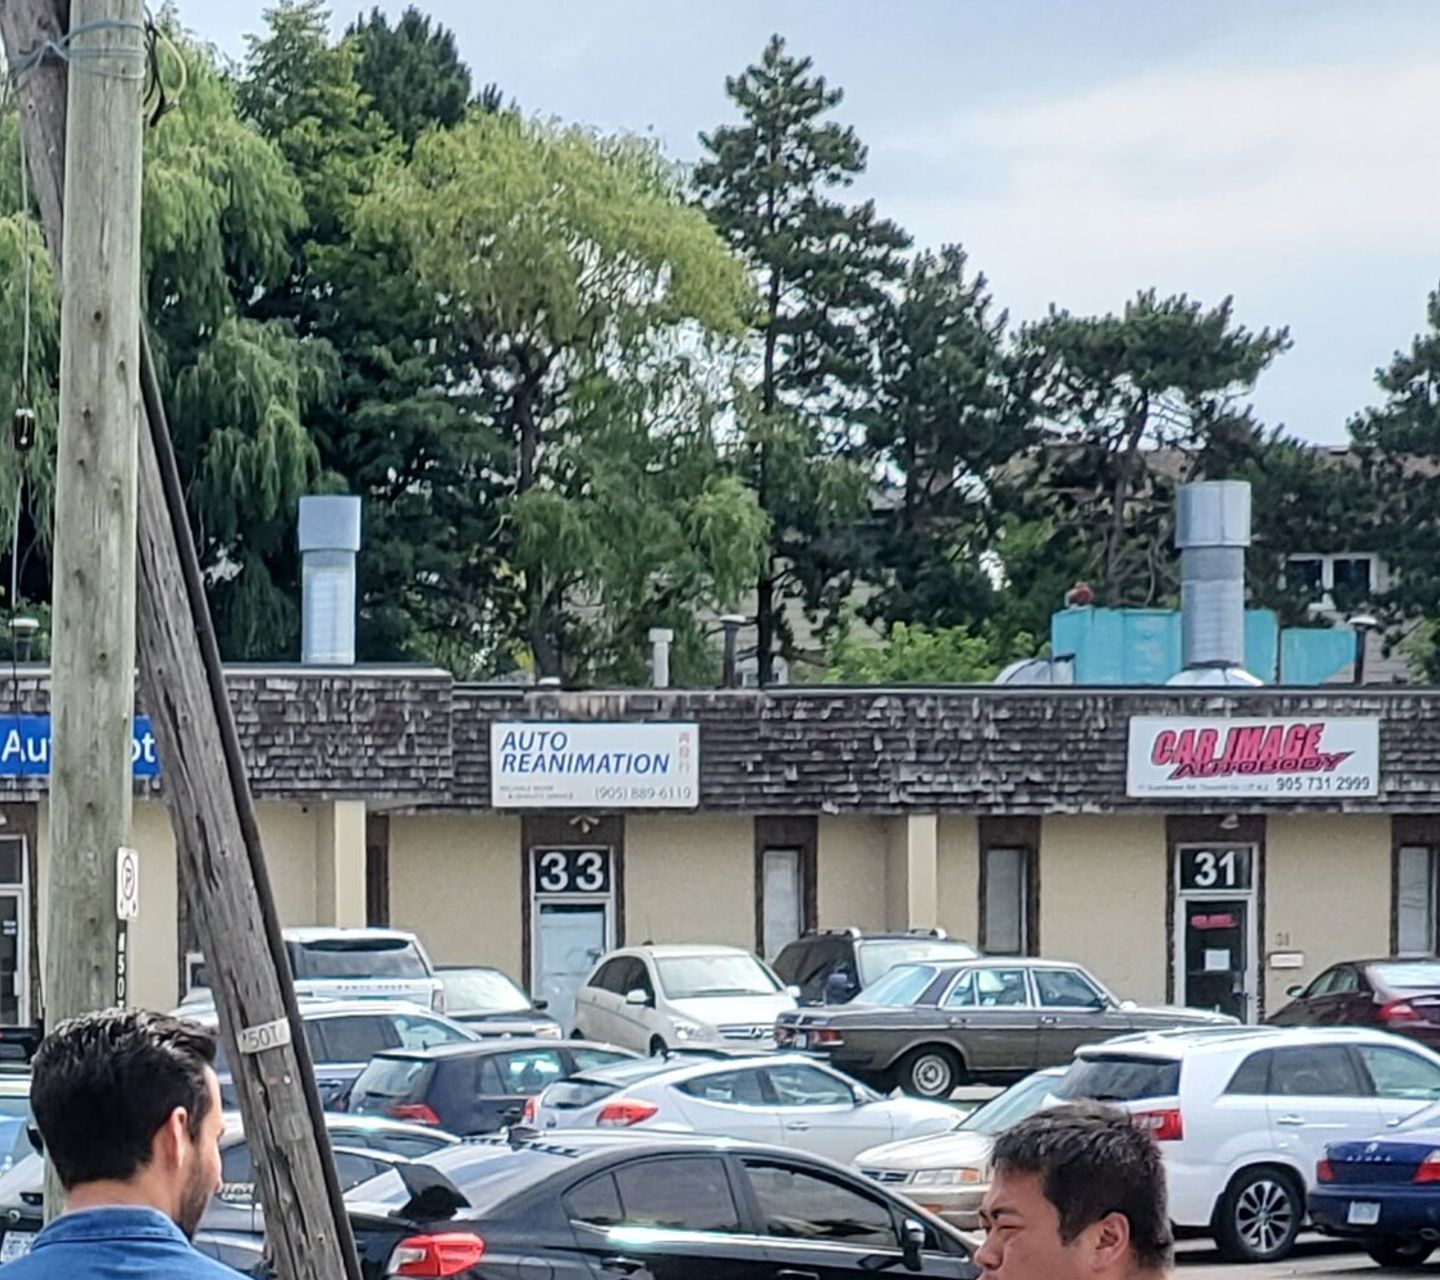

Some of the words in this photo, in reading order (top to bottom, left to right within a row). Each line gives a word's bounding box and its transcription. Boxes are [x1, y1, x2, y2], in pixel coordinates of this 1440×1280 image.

[500, 731, 568, 752] AUTO
[1151, 729, 1219, 765] CAR
[1222, 723, 1326, 764] IMAGE
[501, 753, 670, 775] REANIMATION
[1168, 751, 1356, 781] AUTOBODY
[594, 785, 629, 801] (905)
[1277, 777, 1302, 792] 905
[1310, 776, 1331, 790] 731
[1336, 776, 1371, 790] 2999
[540, 851, 604, 891] 33
[1194, 851, 1236, 887] 31
